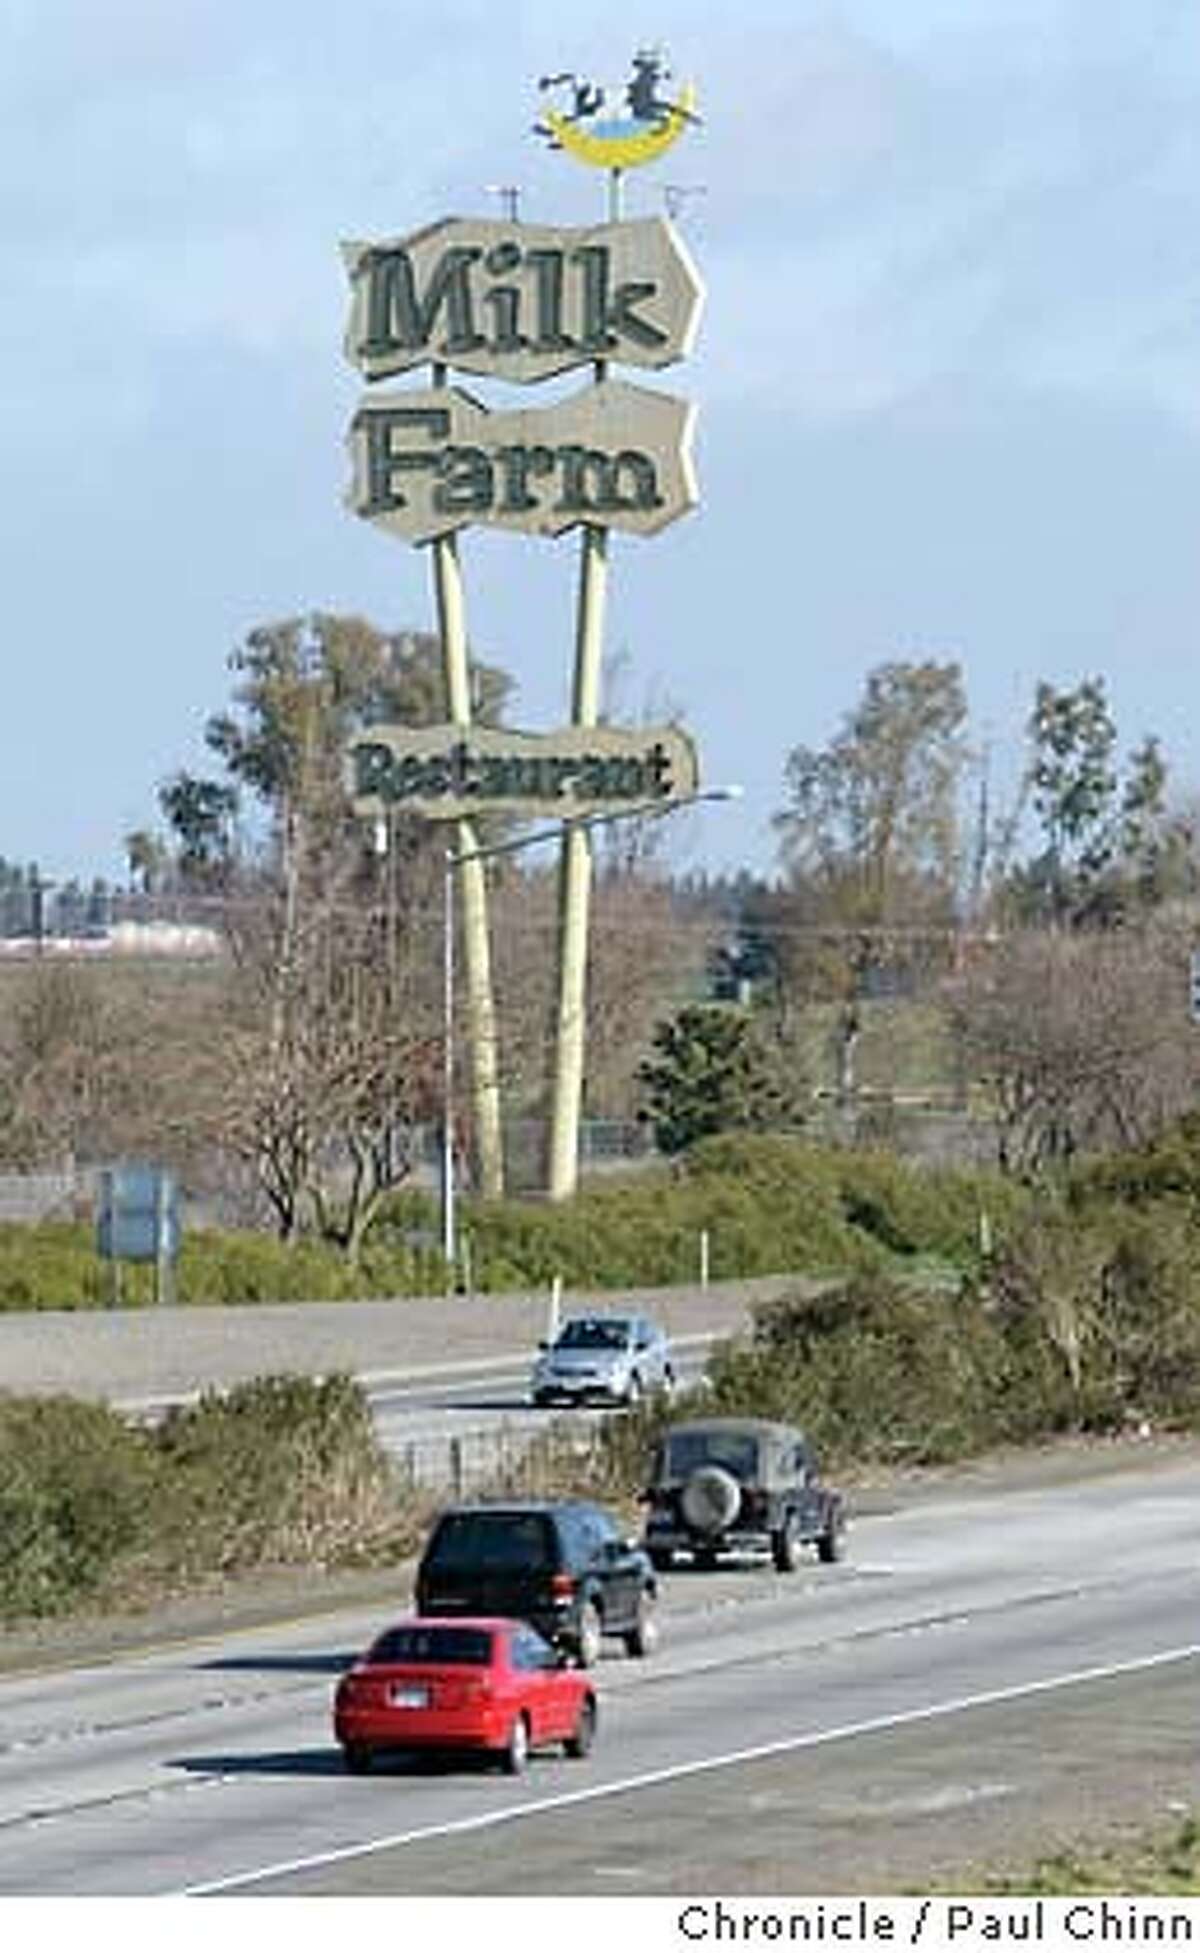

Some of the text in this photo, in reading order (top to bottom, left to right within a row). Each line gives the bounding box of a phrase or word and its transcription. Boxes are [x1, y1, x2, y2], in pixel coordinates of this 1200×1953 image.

[357, 242, 669, 358] Milk
[351, 408, 665, 519] Farm
[352, 742, 674, 800] Restaurant
